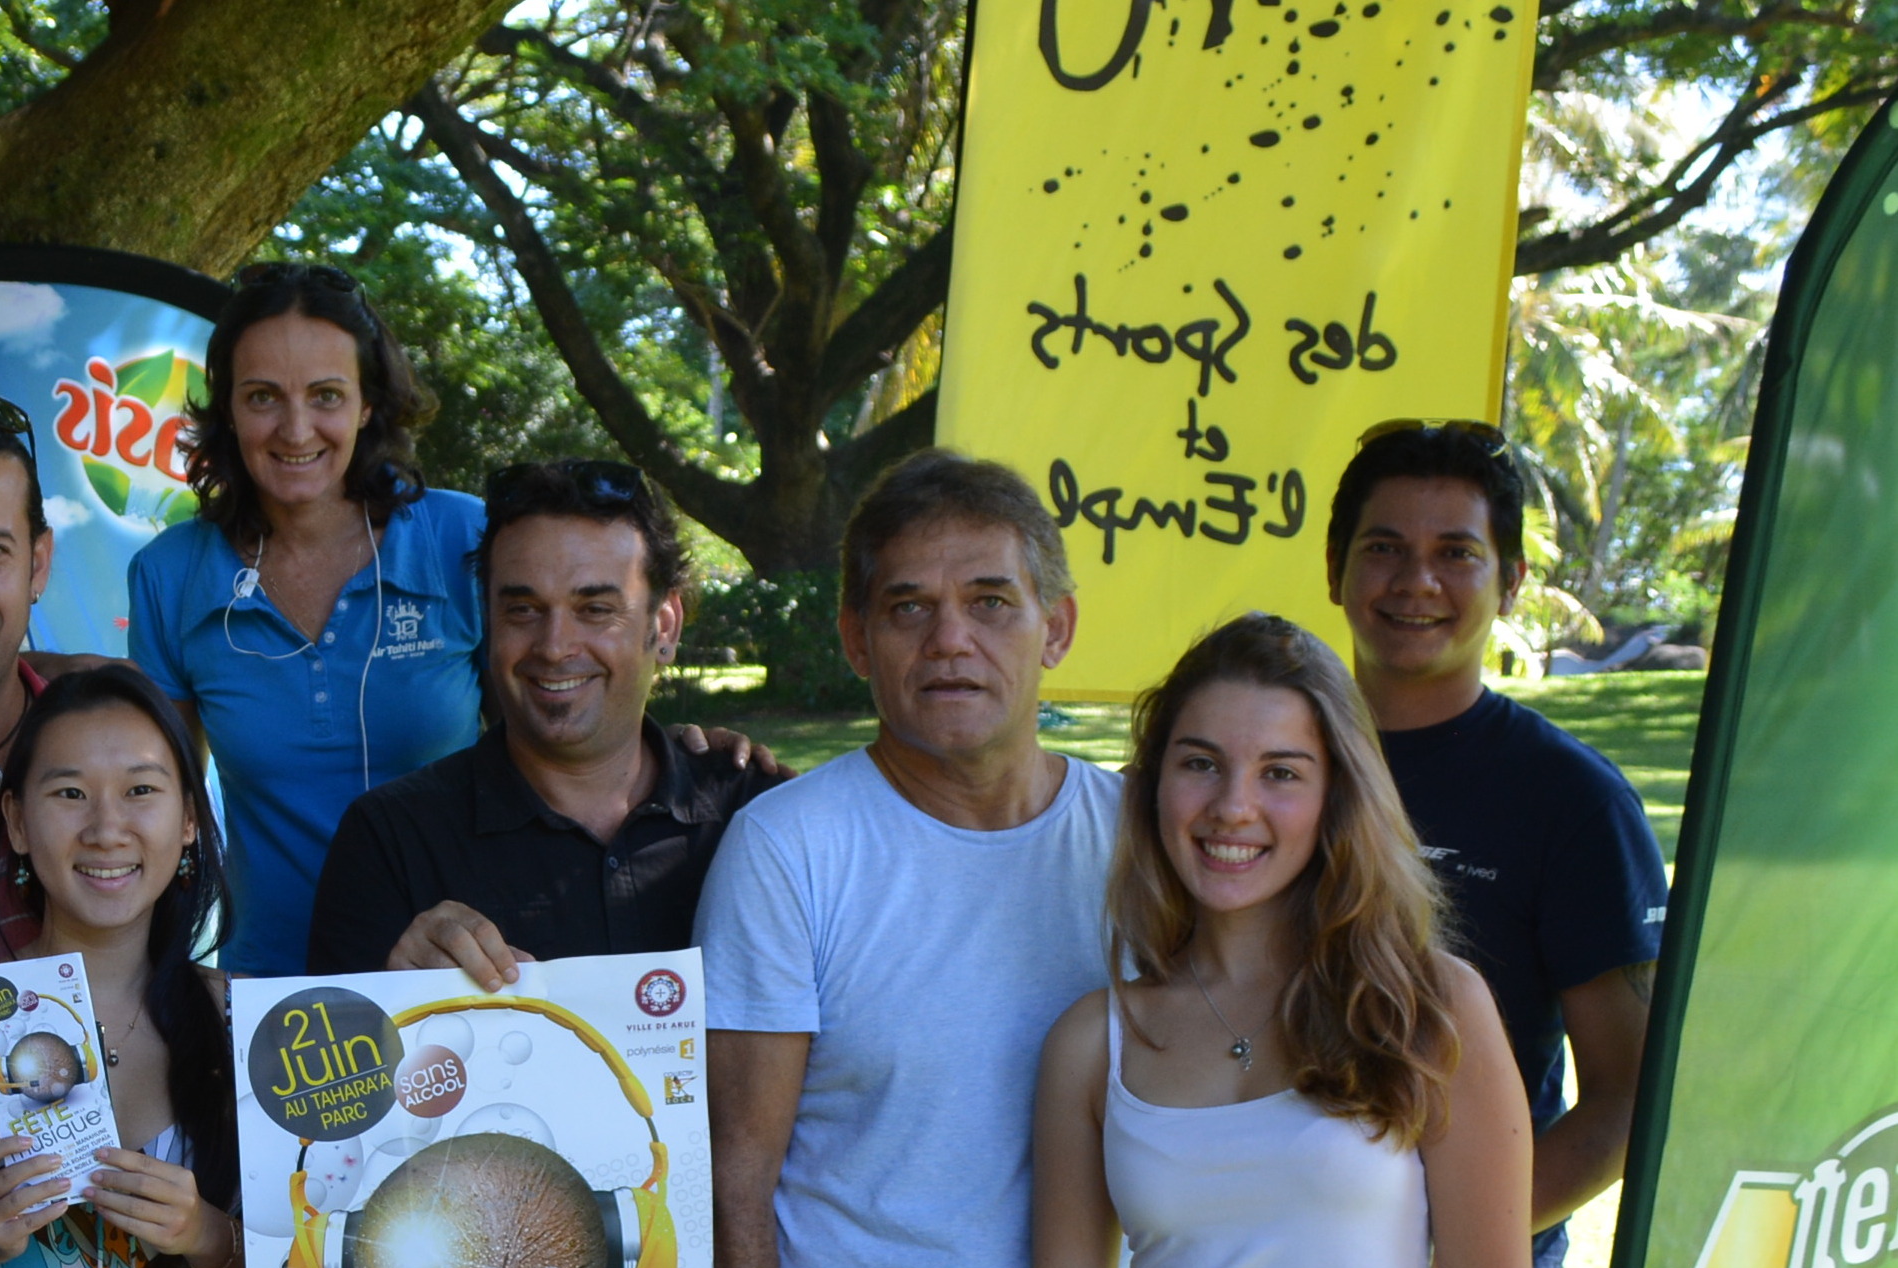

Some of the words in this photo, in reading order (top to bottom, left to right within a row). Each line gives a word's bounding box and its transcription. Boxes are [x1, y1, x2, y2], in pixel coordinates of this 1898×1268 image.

[1643, 906, 1667, 924] BO
[283, 1001, 335, 1050] 21
[626, 1023, 652, 1032] VILLE
[656, 1022, 667, 1030] DE
[671, 1021, 696, 1029] ARUE
[272, 1034, 383, 1096] Juin
[627, 1044, 676, 1058] polynésie
[400, 1059, 458, 1094] sans
[404, 1076, 466, 1109] ALCOOL
[285, 1098, 308, 1120] AU
[320, 1102, 368, 1131] PARC
